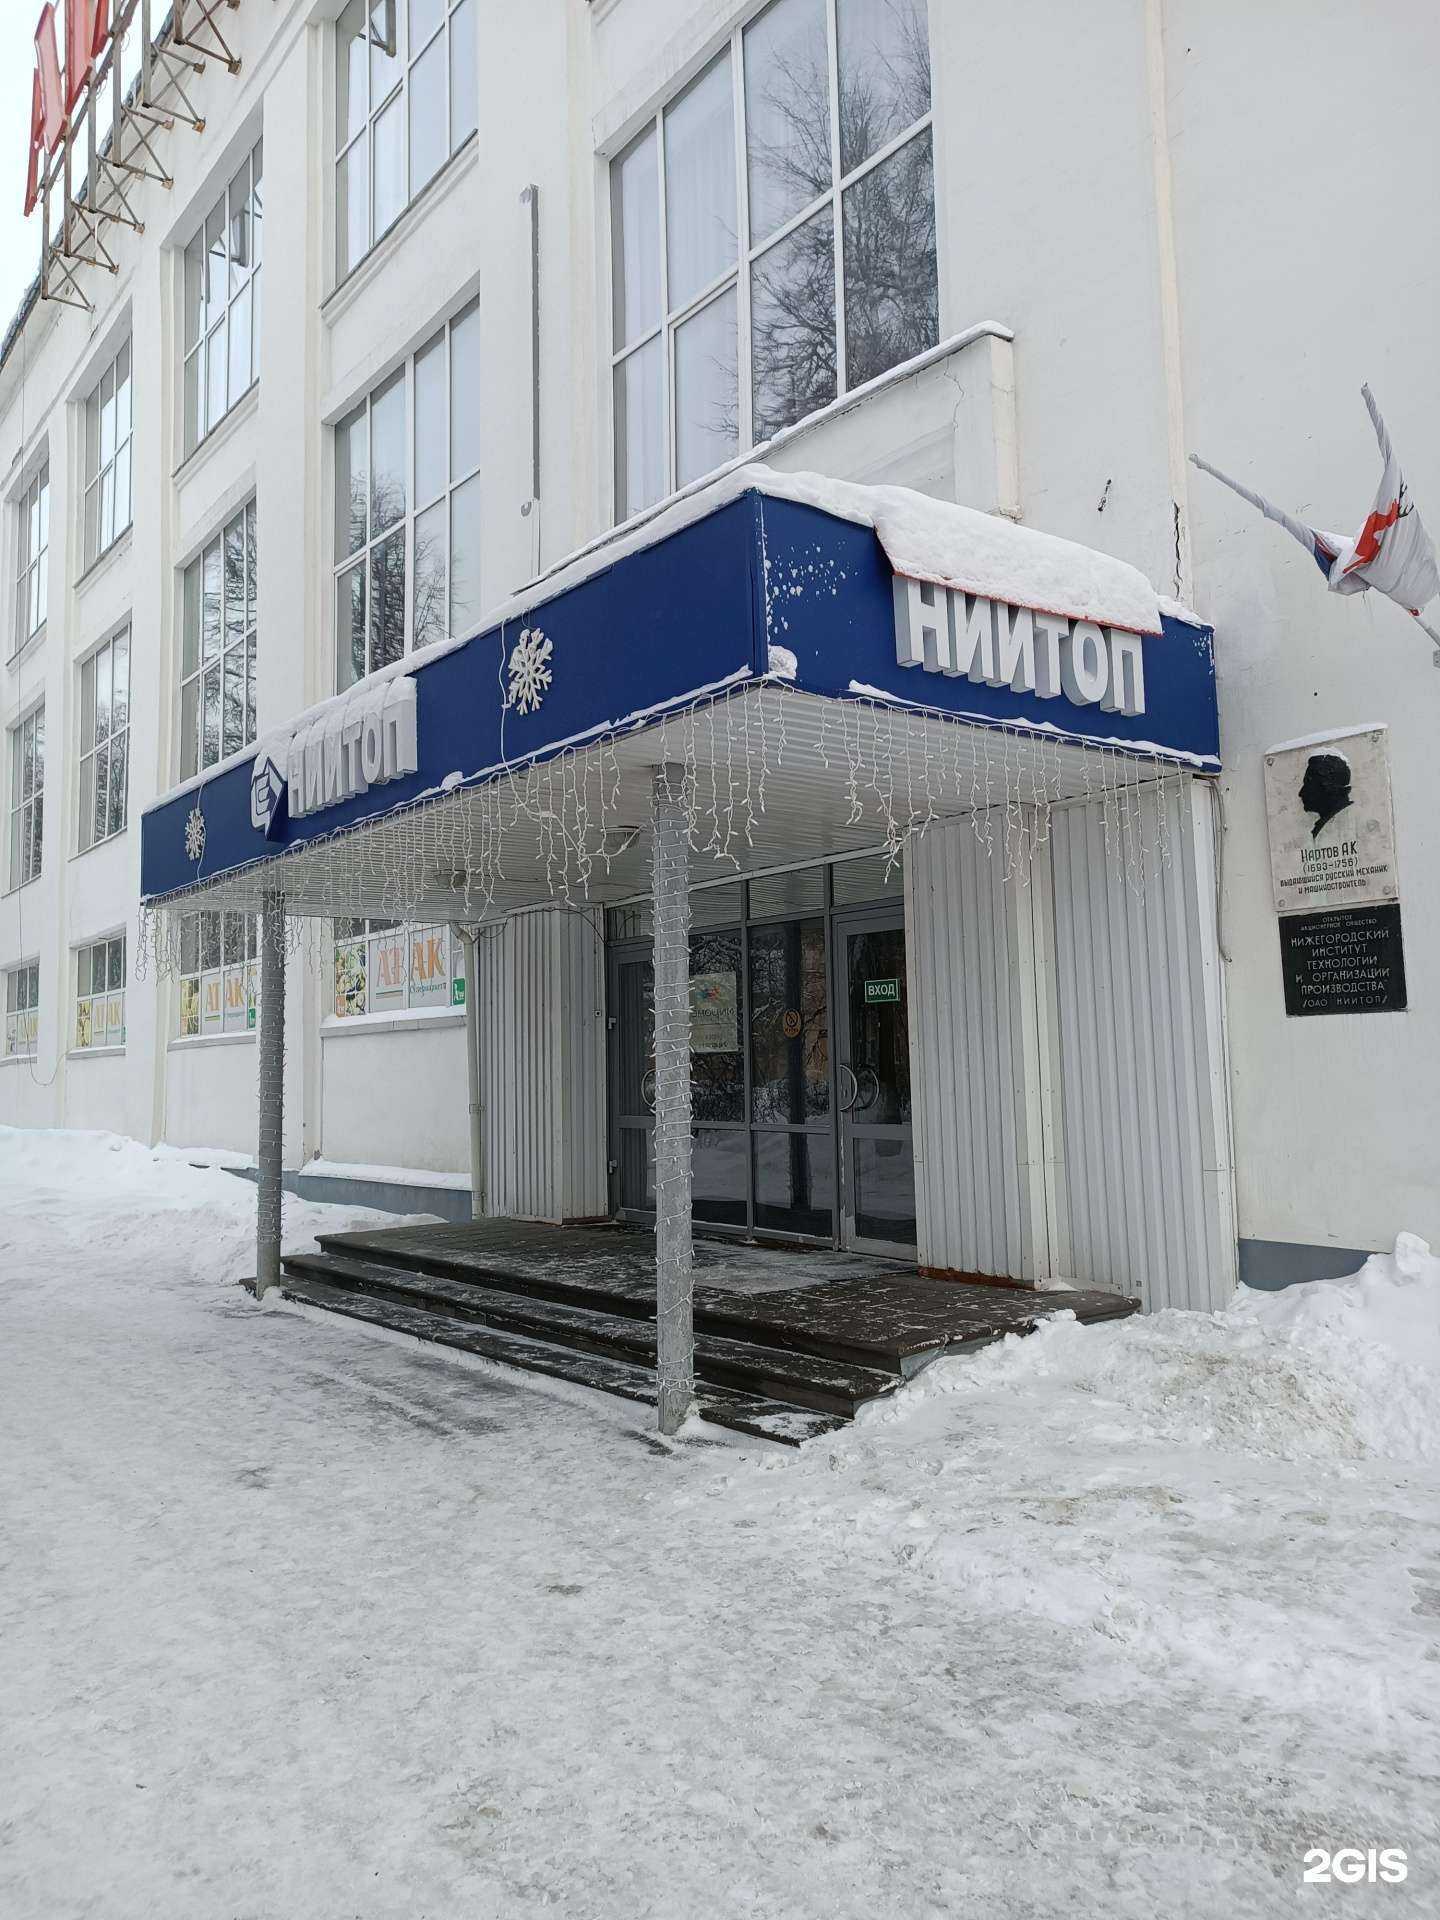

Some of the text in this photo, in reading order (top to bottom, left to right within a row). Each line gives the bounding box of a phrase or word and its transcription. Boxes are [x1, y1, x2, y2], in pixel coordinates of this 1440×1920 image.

[892, 575, 1145, 717] НИИТОП
[287, 690, 418, 818] НИИТОП
[1356, 864, 1388, 876] МЕХАНИК
[1312, 943, 1368, 957] ИНСТИТУТ
[1307, 955, 1378, 970] ТЕХНОЛОГИИ
[1295, 967, 1390, 984] И ОРГАНИЗАЦИИ
[868, 983, 896, 997] ВХОД
[1301, 981, 1385, 996] ПРОИЗВОДСТВА
